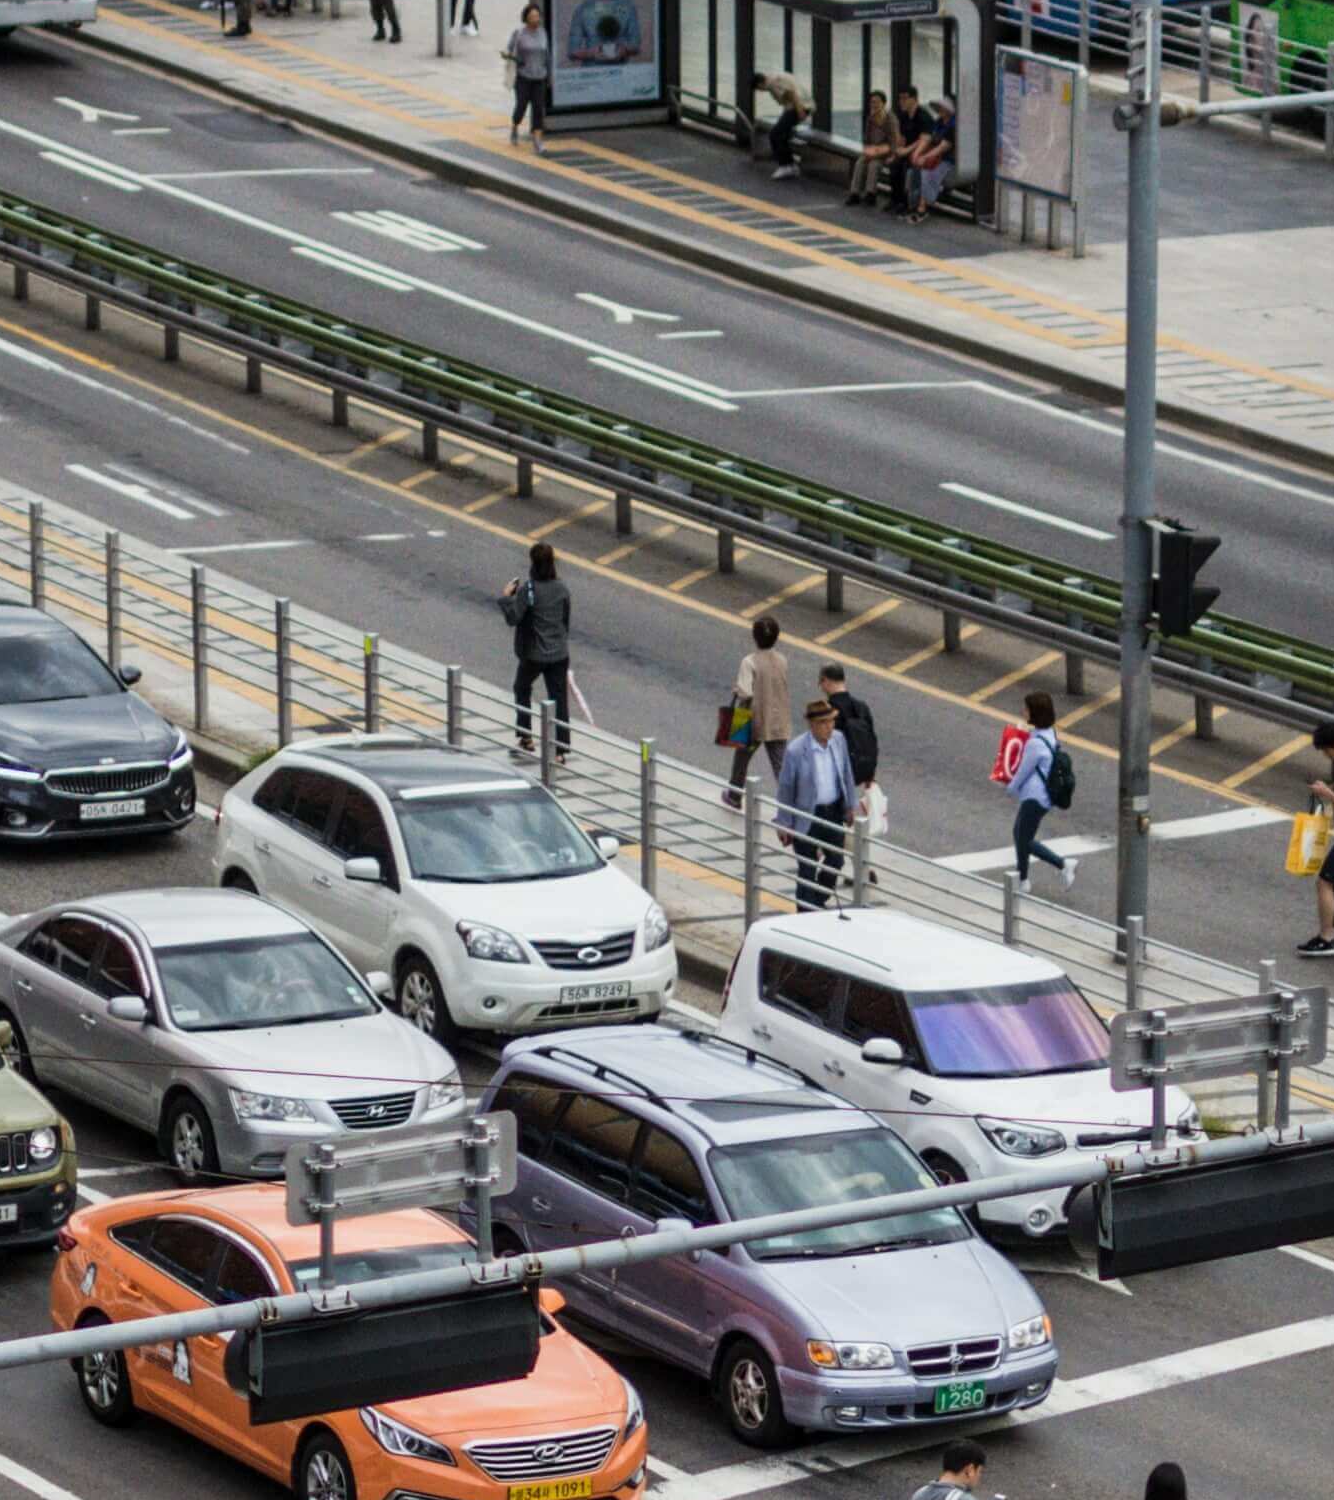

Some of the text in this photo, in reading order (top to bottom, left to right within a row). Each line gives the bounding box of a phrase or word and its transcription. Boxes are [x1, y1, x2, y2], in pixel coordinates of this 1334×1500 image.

[595, 984, 623, 998] 8249
[941, 1388, 984, 1410] 1280
[555, 1481, 586, 1498] 1091
